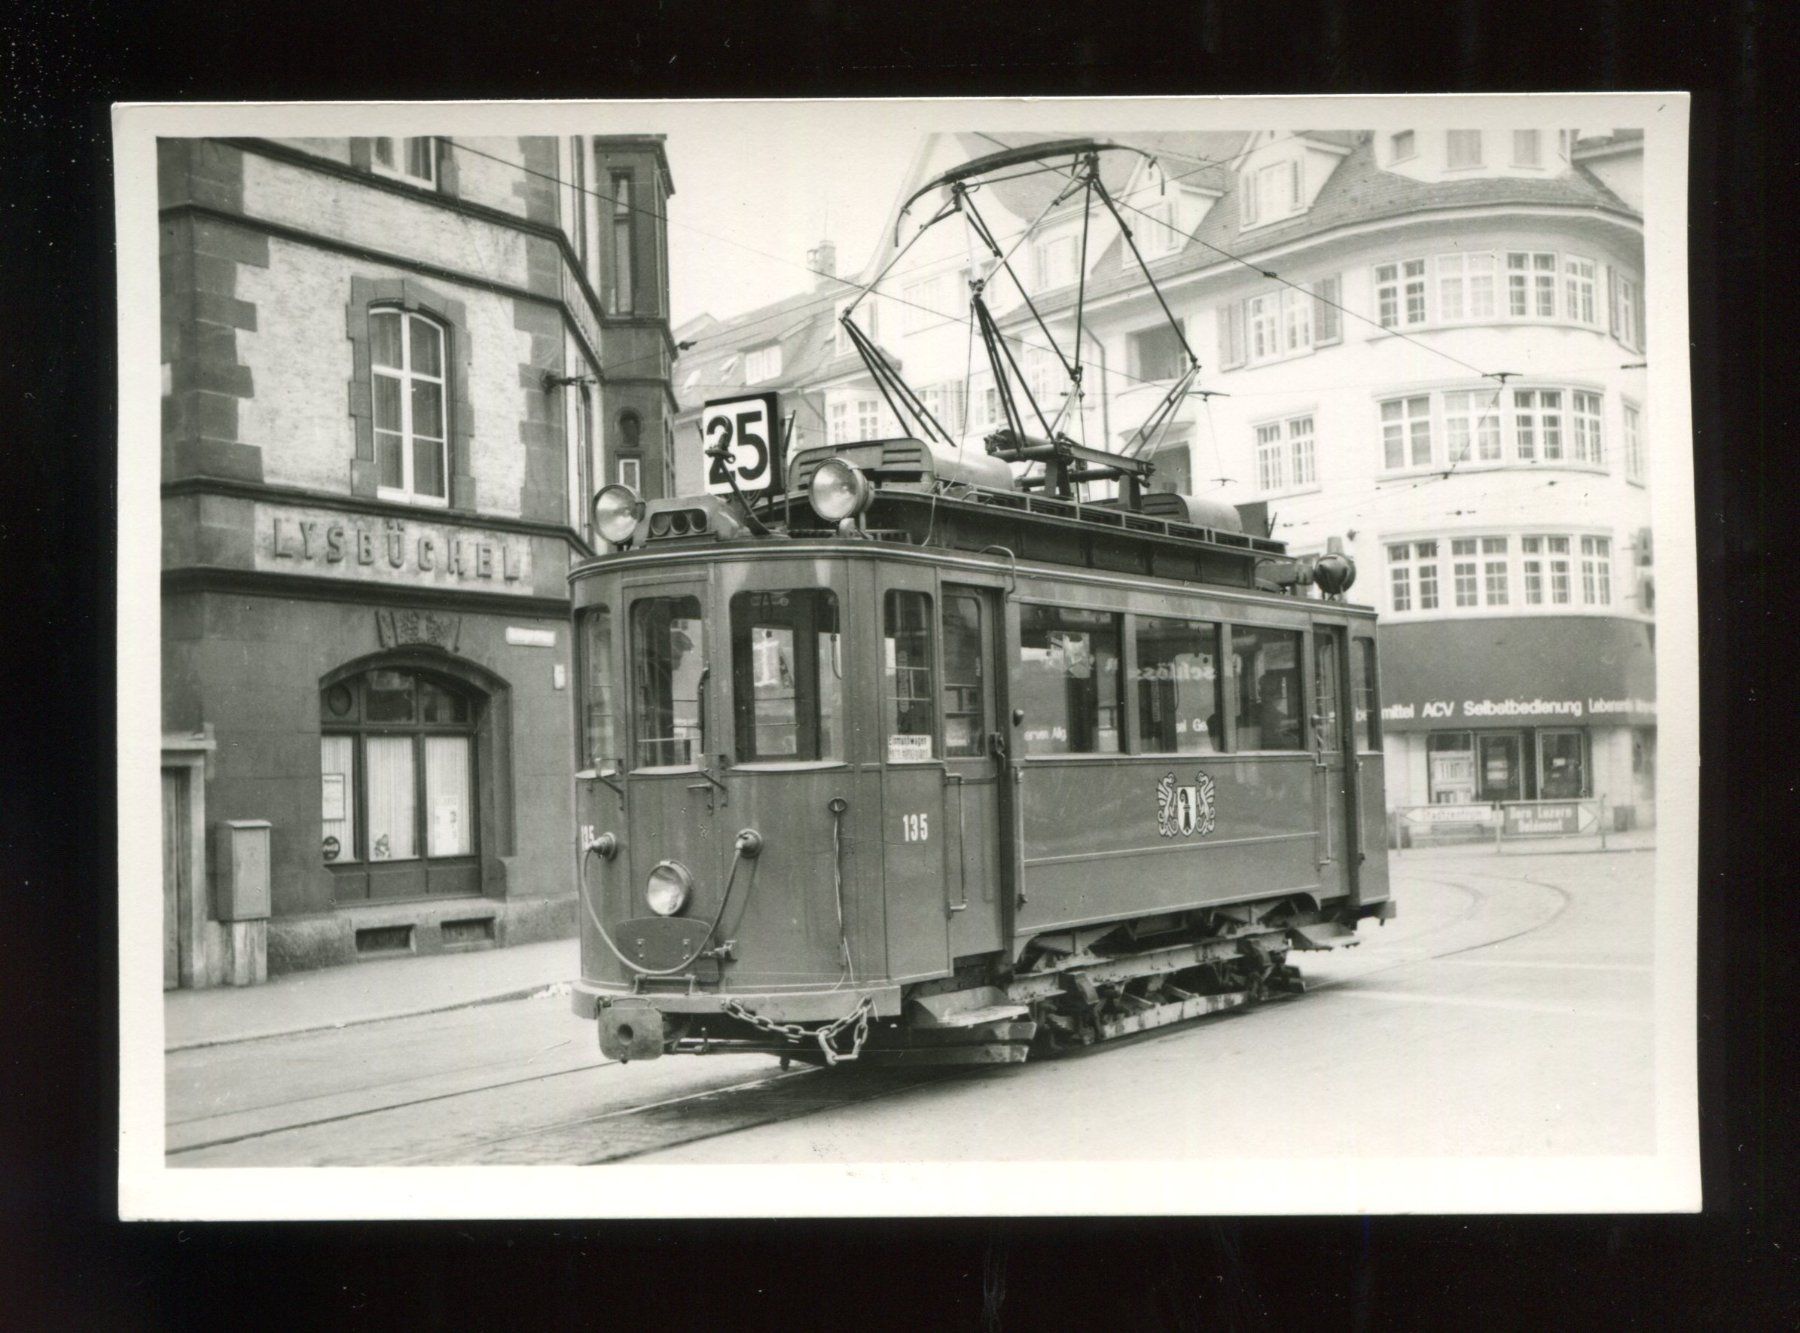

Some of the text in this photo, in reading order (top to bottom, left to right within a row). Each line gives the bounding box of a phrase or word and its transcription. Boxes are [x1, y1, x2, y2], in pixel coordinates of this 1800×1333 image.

[706, 410, 769, 485] 25
[273, 517, 520, 581] LYSBÜCHEL
[1422, 702, 1455, 718] ACV
[1463, 698, 1582, 718] Selbstbedienung
[902, 813, 929, 842] 135
